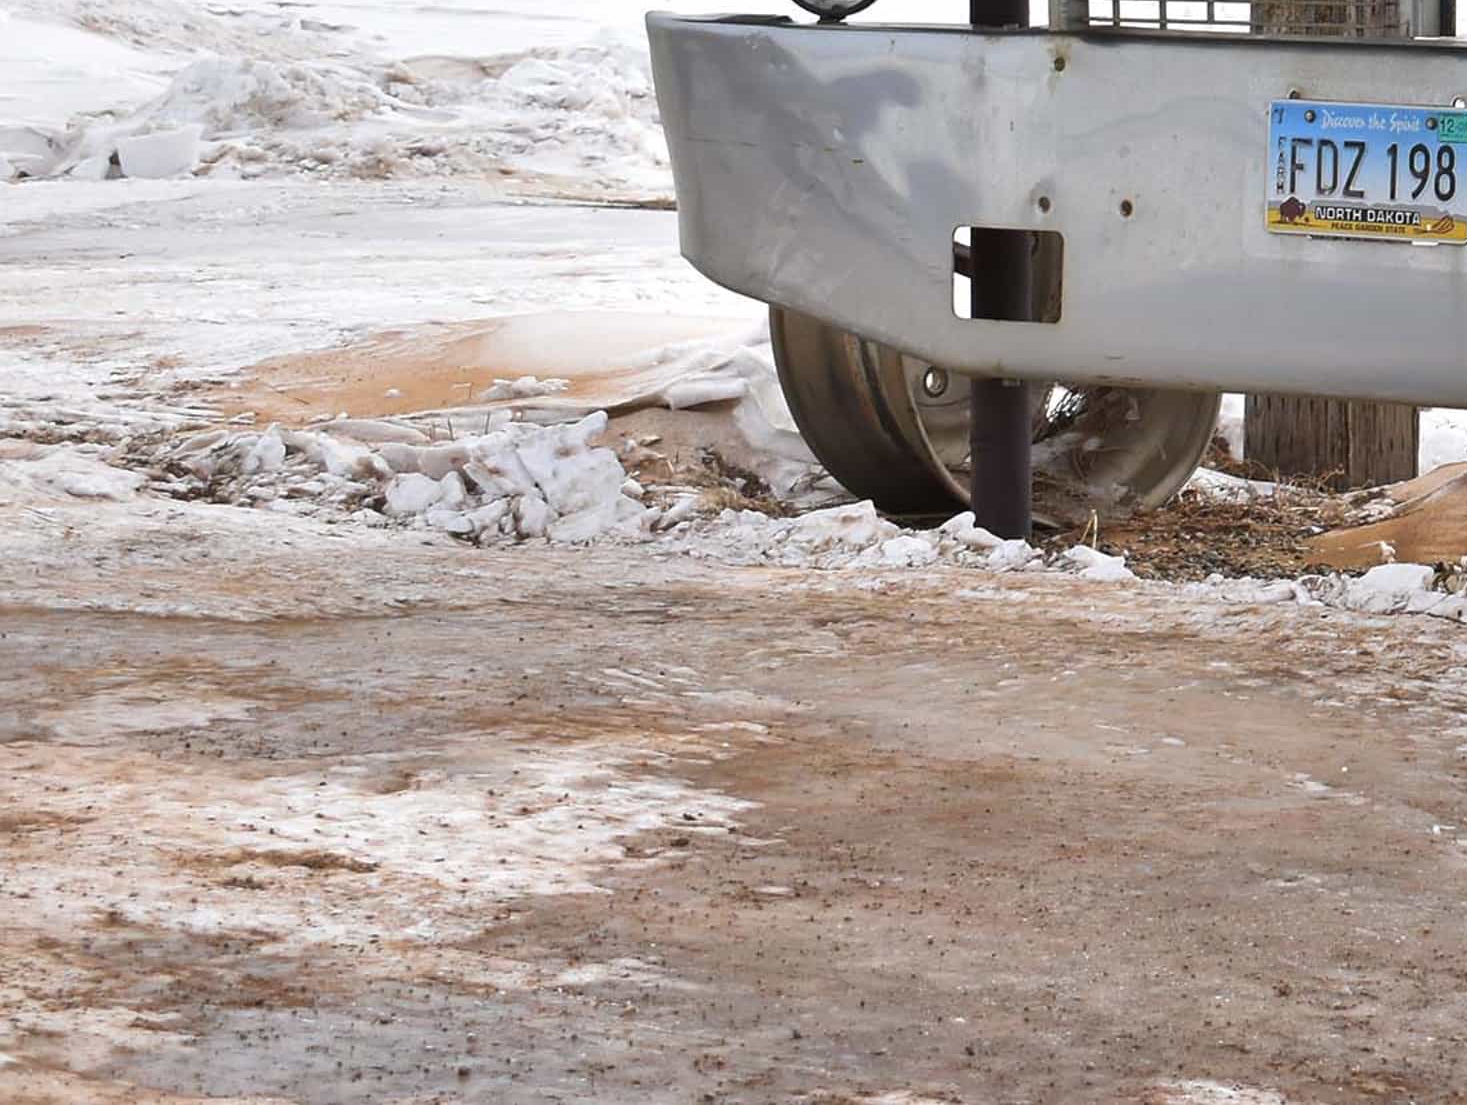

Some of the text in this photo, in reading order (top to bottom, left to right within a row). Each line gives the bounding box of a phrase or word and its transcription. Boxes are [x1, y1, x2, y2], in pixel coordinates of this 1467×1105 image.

[1368, 112, 1387, 130] the
[1290, 137, 1457, 202] FDZ 198
[1315, 206, 1420, 225] NORTH DAKOTA
